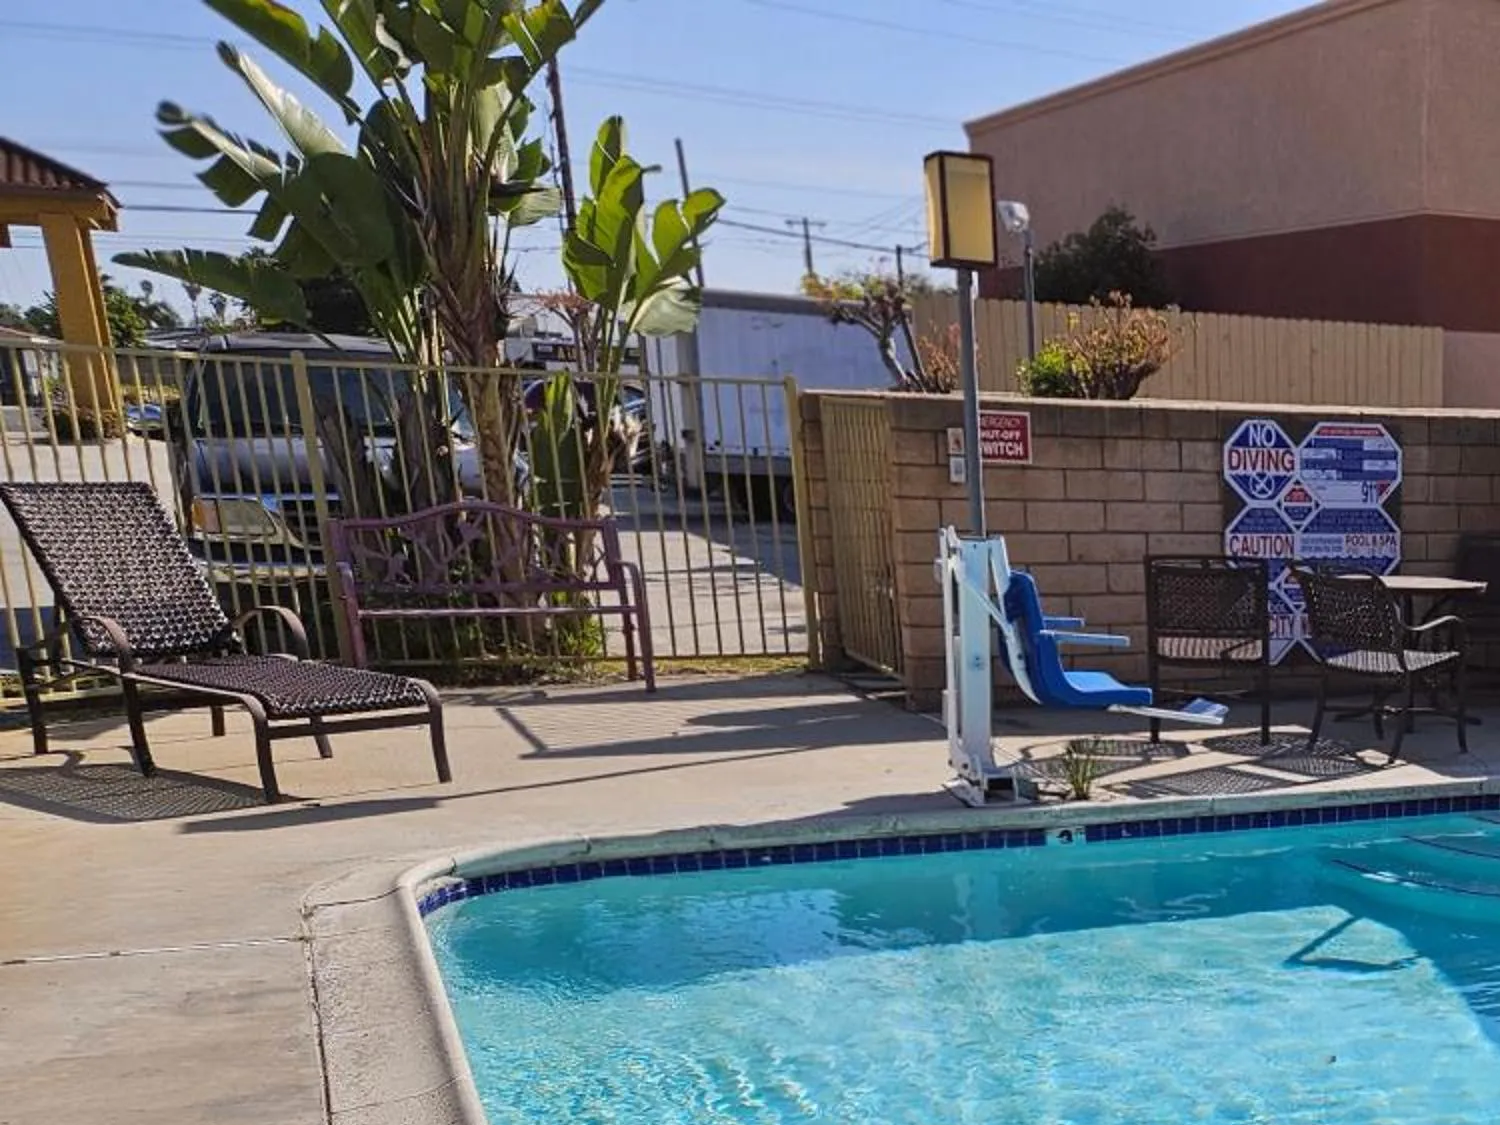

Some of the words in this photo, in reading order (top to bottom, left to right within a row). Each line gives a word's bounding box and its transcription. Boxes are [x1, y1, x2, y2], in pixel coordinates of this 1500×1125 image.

[1248, 423, 1276, 447] NO
[981, 440, 1025, 456] WITCH
[1228, 450, 1295, 472] DIVING
[1229, 535, 1295, 556] CAUTION
[1345, 535, 1370, 546] POOL
[1379, 535, 1398, 546] SPA
